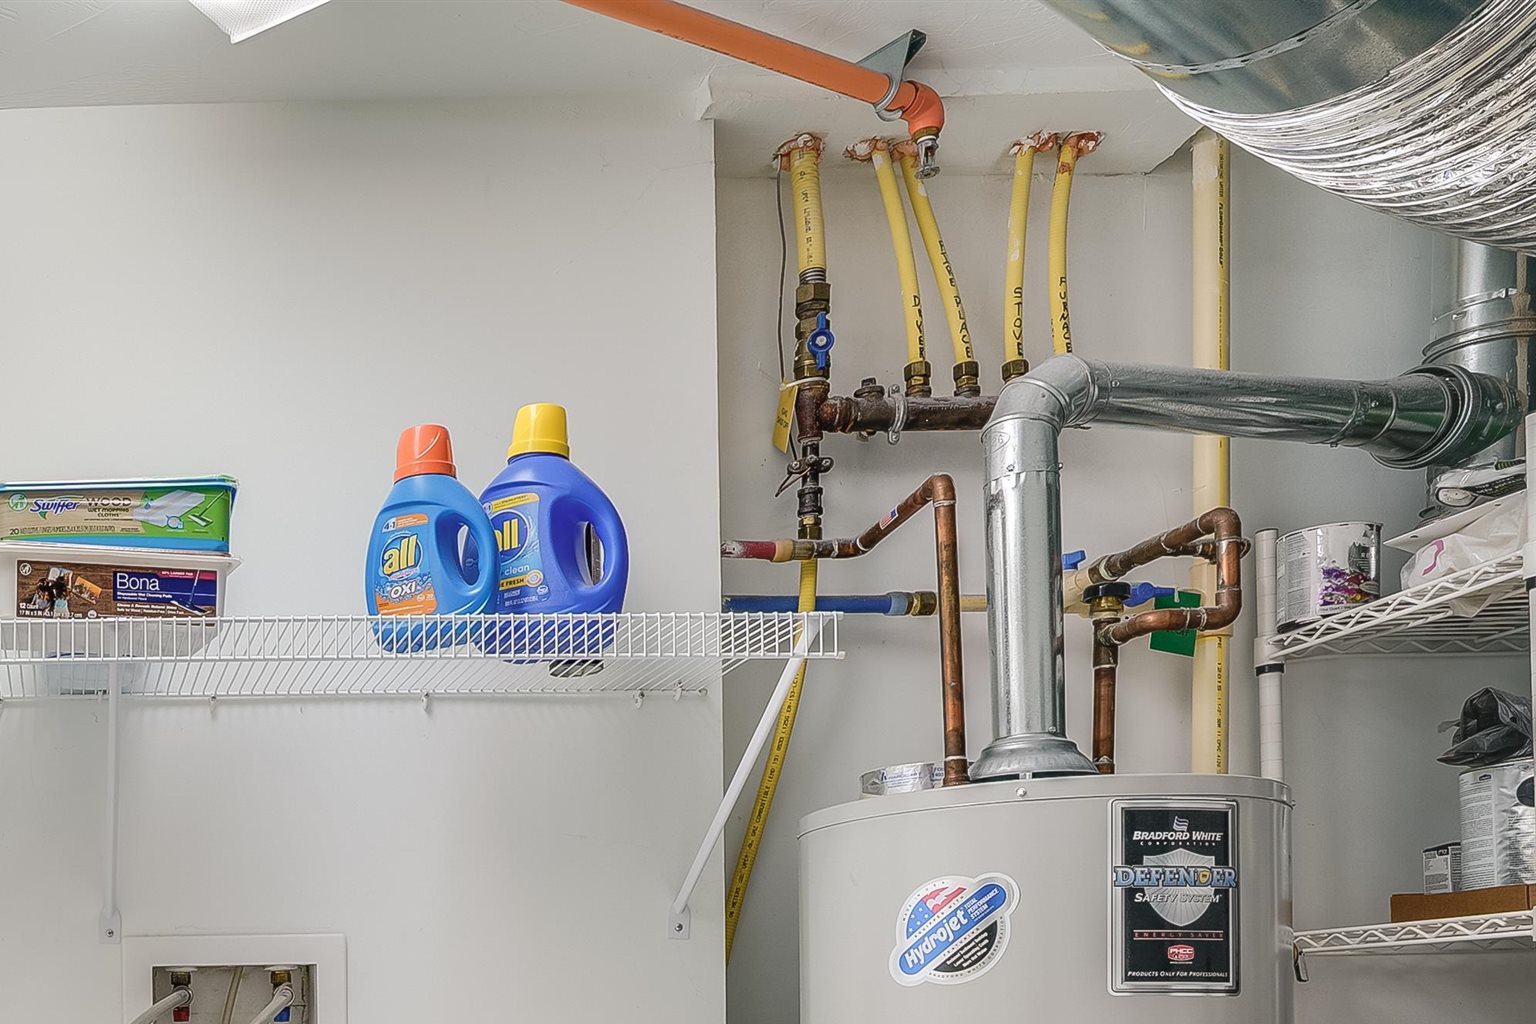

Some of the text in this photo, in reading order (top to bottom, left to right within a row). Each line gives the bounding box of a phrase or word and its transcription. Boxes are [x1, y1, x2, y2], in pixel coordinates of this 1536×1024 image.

[1012, 287, 1024, 356] STOVE
[1058, 277, 1072, 353] FURNACE
[911, 295, 925, 359] DRYER
[954, 296, 972, 358] PLACE
[30, 497, 132, 514] Swiffer WOOD
[383, 534, 418, 575] all
[504, 564, 530, 576] clean
[116, 573, 160, 590] Bona
[390, 582, 417, 598] OXI
[1132, 831, 1224, 841] BRADFORD WHITE
[1114, 866, 1238, 887] DEFENDER
[1134, 893, 1177, 903] SAFETY
[904, 908, 968, 968] Hydrojet
